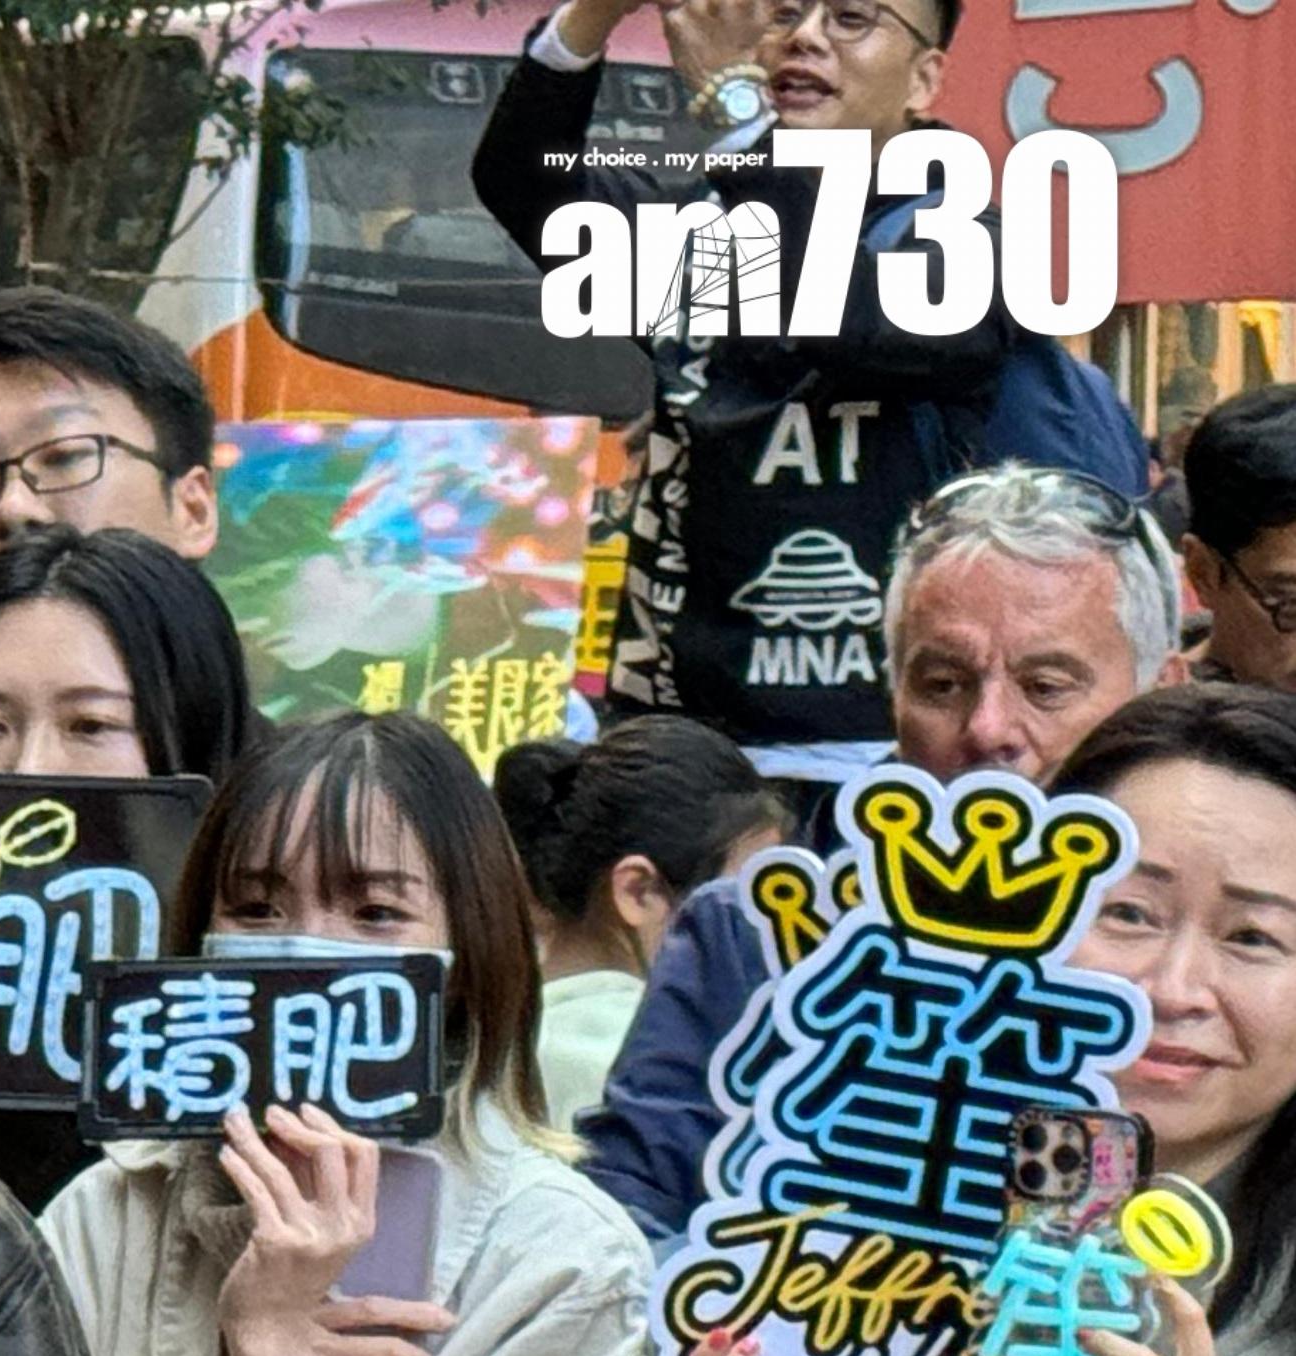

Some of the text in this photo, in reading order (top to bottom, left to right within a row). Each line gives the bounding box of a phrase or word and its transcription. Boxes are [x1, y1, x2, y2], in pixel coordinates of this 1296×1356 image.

[751, 401, 881, 486] AT
[746, 633, 878, 686] MNA
[106, 972, 418, 1122] 積肥
